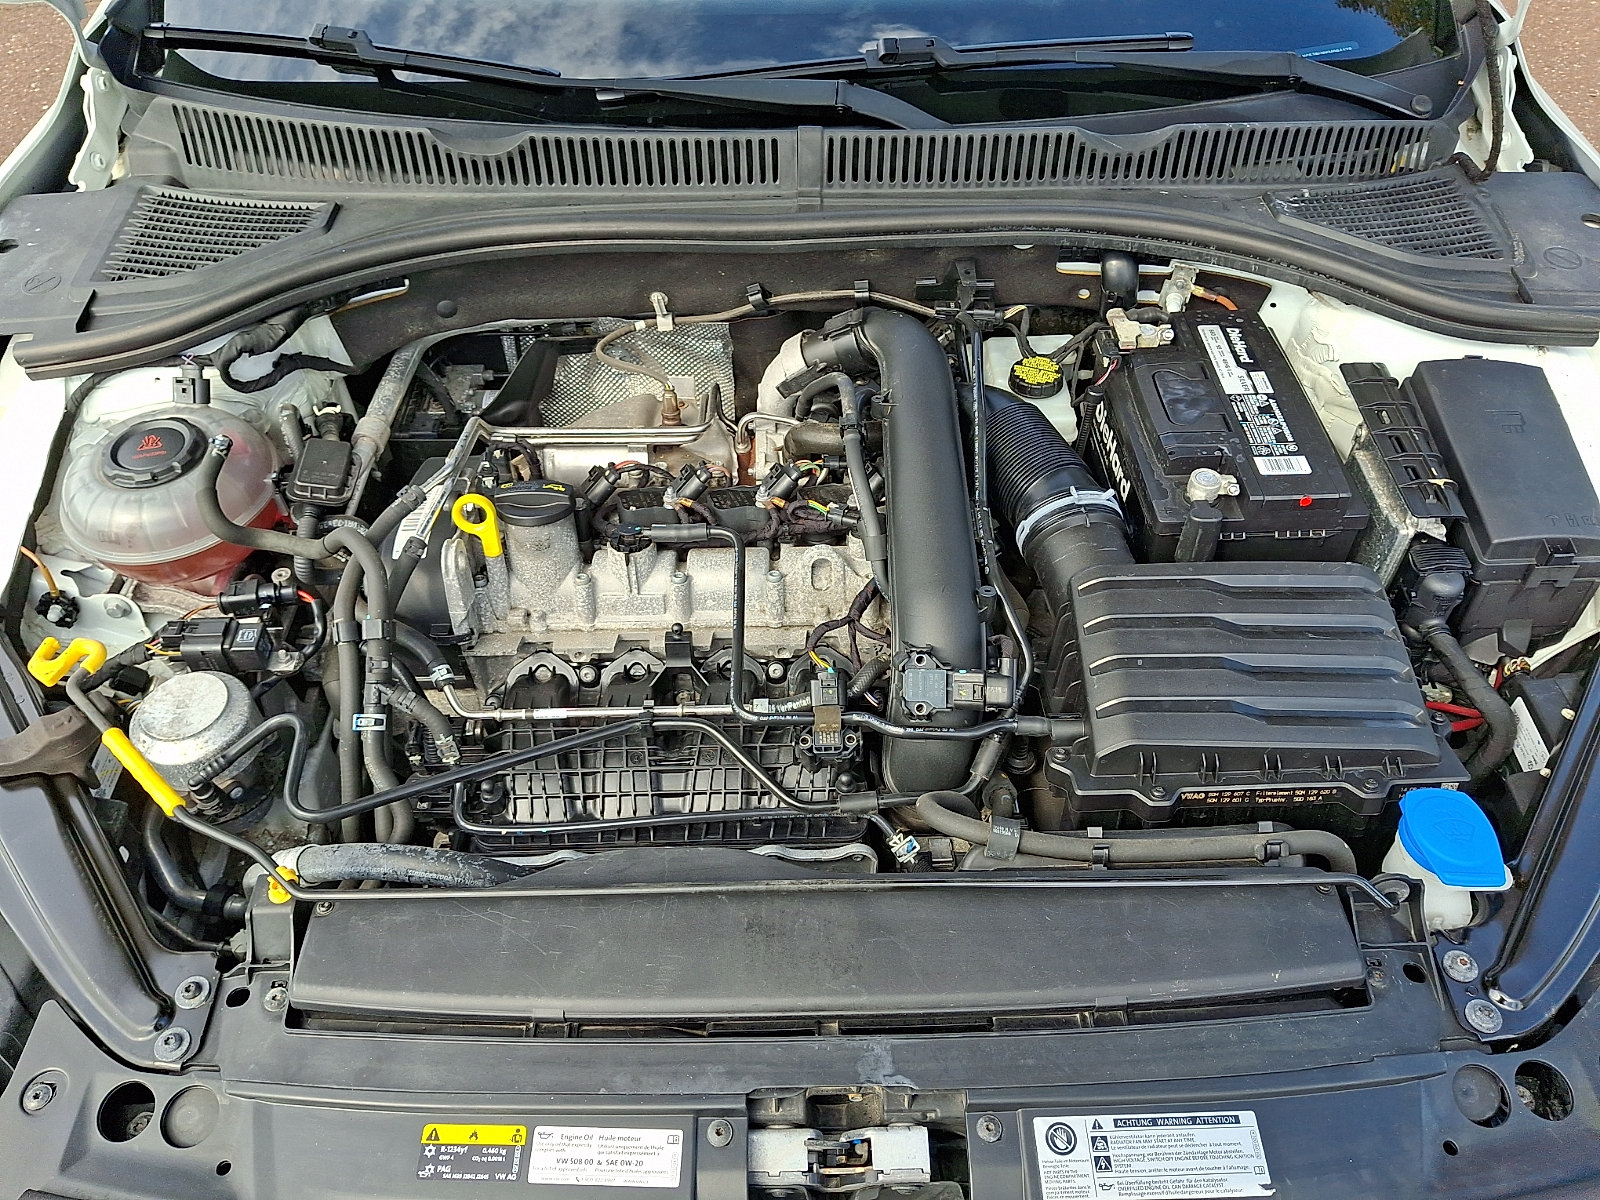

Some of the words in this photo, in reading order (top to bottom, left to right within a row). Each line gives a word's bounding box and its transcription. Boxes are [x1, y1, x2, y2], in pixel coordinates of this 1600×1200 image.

[1226, 328, 1254, 362] DieHard
[1238, 375, 1250, 392] SILVER
[1096, 400, 1130, 502] DieHard
[1196, 1116, 1235, 1124] ATTENTION
[440, 1146, 468, 1155] R-1234yf
